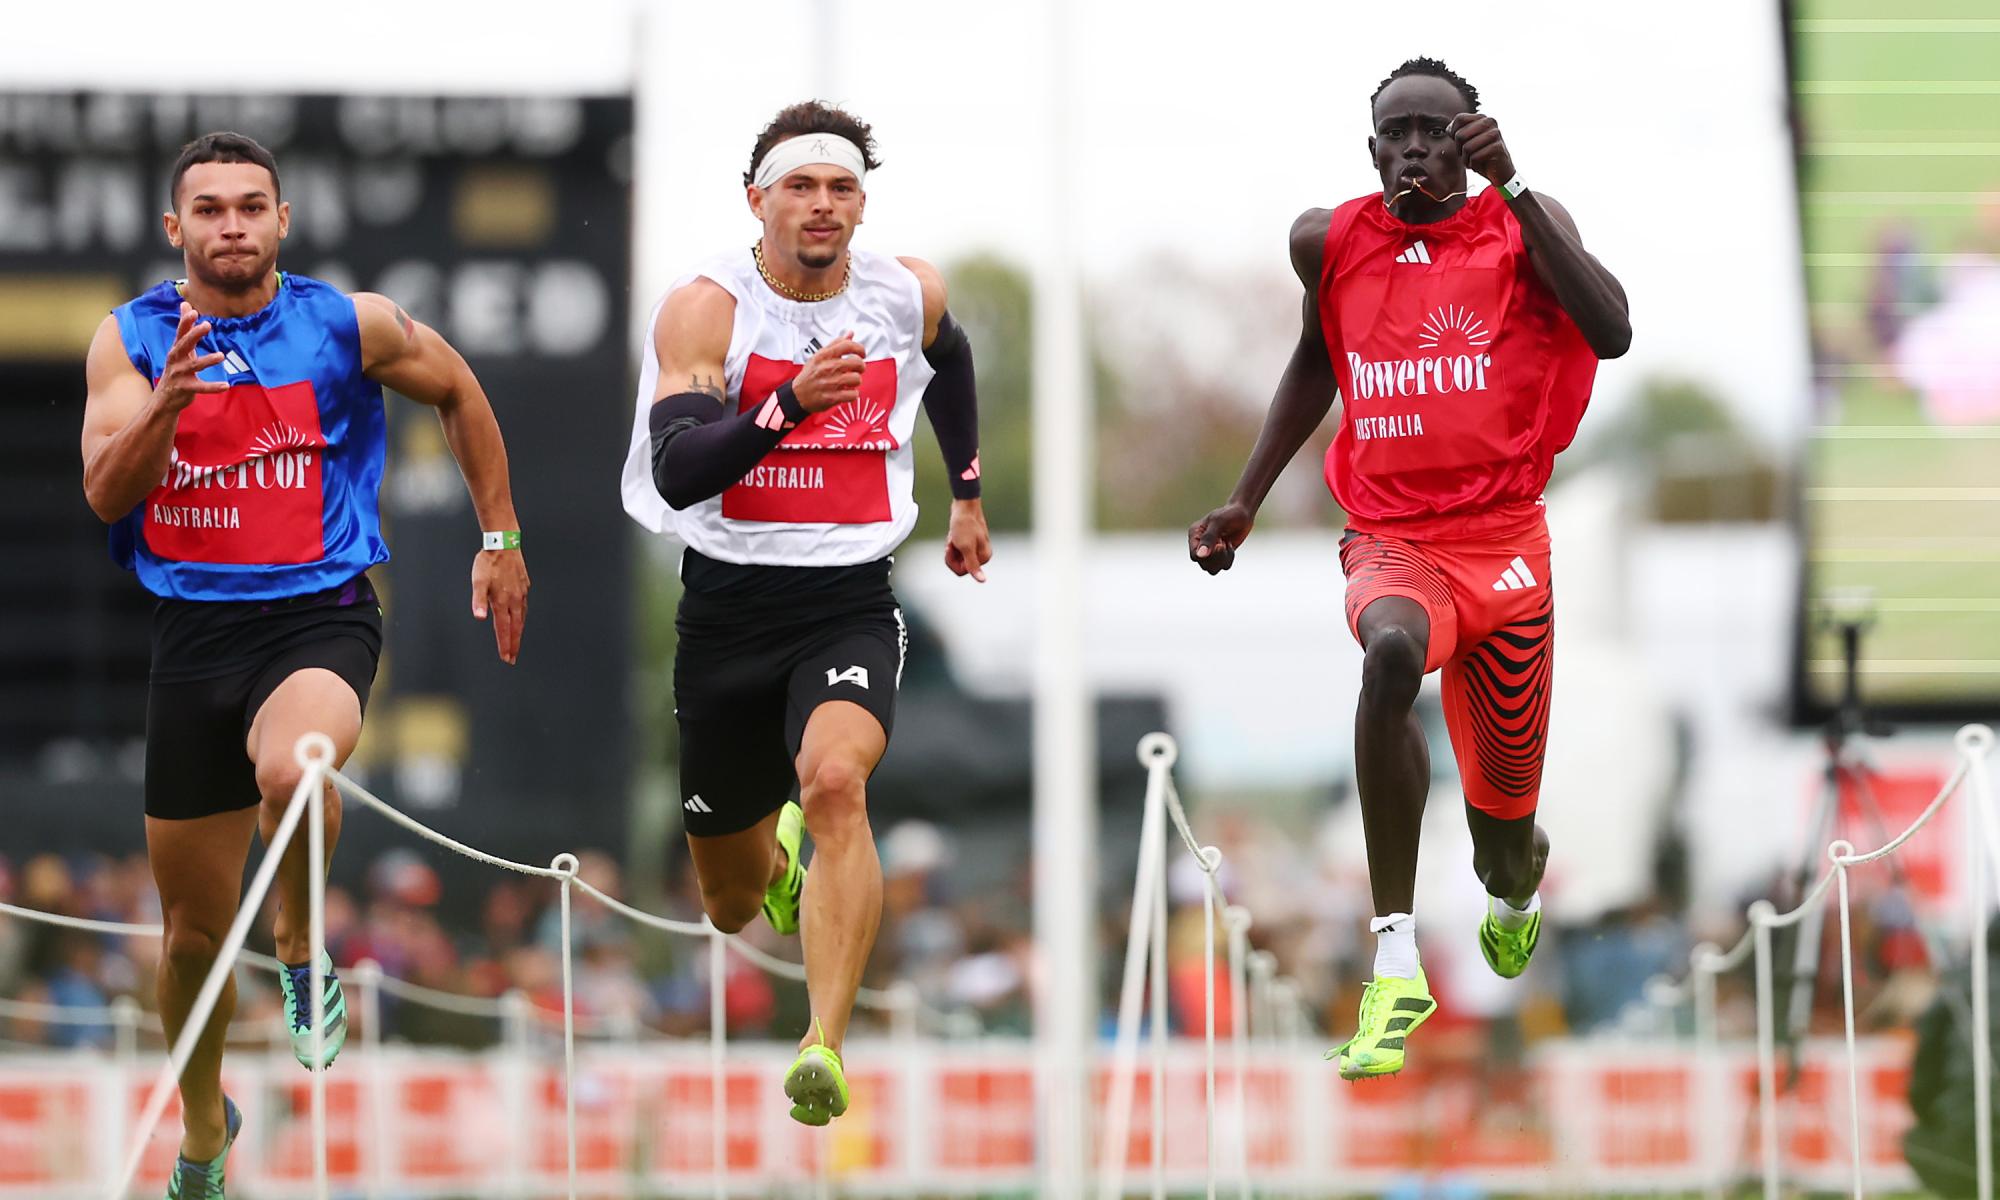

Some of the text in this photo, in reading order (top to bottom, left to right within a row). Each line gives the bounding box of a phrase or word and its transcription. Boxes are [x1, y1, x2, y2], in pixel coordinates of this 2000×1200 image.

[1347, 351, 1492, 400] Powercor
[739, 465, 824, 488] USTRALIA
[154, 503, 241, 529] AUSTRALIA
